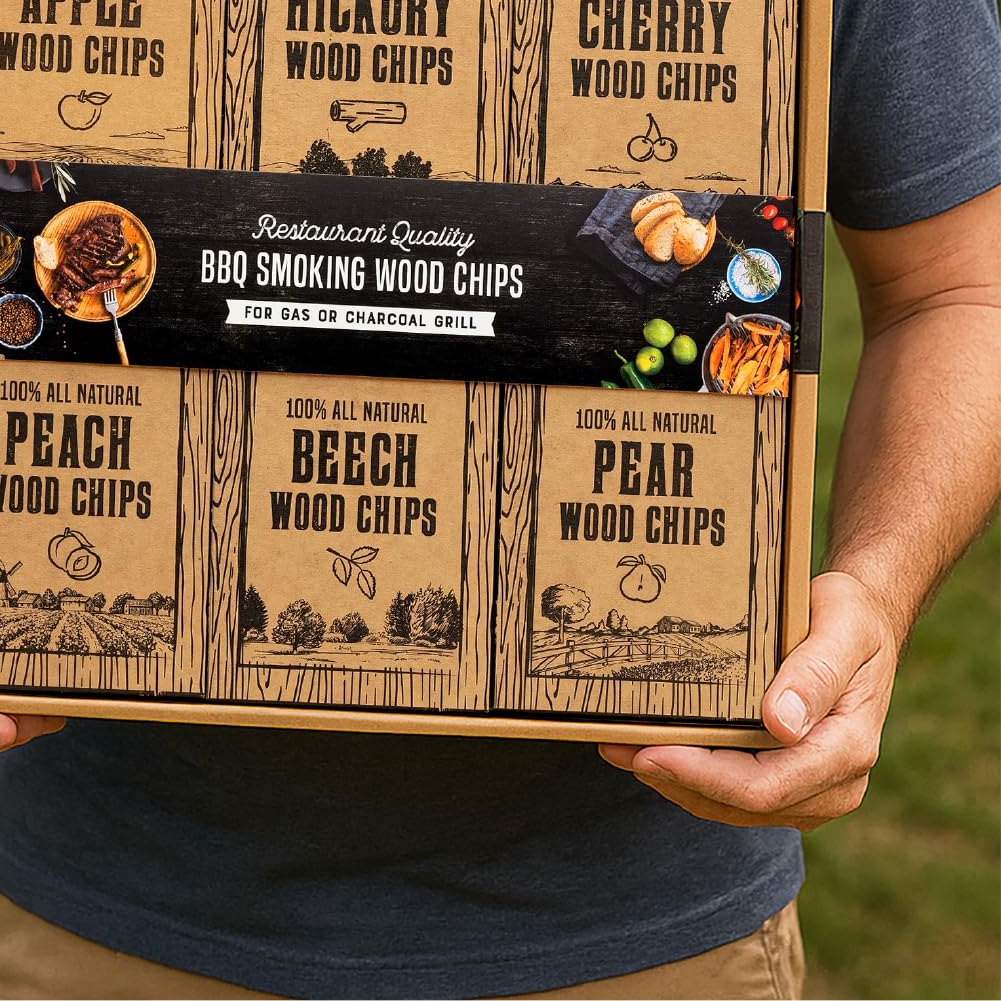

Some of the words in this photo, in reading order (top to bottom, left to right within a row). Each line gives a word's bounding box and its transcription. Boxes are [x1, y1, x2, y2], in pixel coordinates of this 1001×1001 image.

[85, 36, 164, 77] CHIPS
[286, 41, 360, 82] WOOD
[373, 45, 453, 85] CHIPS
[571, 59, 645, 99] WOOD
[658, 62, 736, 103] CHIPS
[252, 214, 387, 243] Restaurant
[390, 221, 475, 256] Quality
[201, 250, 247, 288] BBQ
[257, 252, 364, 290] SMOKING
[376, 258, 444, 293] WOOD
[454, 262, 523, 298] CHIPS
[245, 306, 272, 319] FOR
[282, 308, 309, 321] GAS
[319, 310, 337, 322] OR
[346, 311, 426, 326] CHARCOAL
[435, 316, 476, 329] GRILL
[0, 381, 40, 402] 100%
[47, 383, 71, 403] ALL
[78, 384, 142, 406] NATURAL
[286, 398, 326, 419] 100%
[332, 400, 357, 420] ALL
[364, 401, 427, 423] NATURAL
[4, 411, 132, 470] PEACH
[576, 409, 616, 430] 100%
[622, 411, 646, 431] ALL
[653, 412, 716, 434] NATURAL
[292, 429, 417, 487] BEECH
[592, 440, 693, 497] PEAR
[72, 478, 151, 519] CHIPS
[270, 492, 345, 532] WOOD
[357, 495, 436, 536] CHIPS
[560, 502, 634, 542] WOOD
[646, 506, 725, 546] CHIPS
